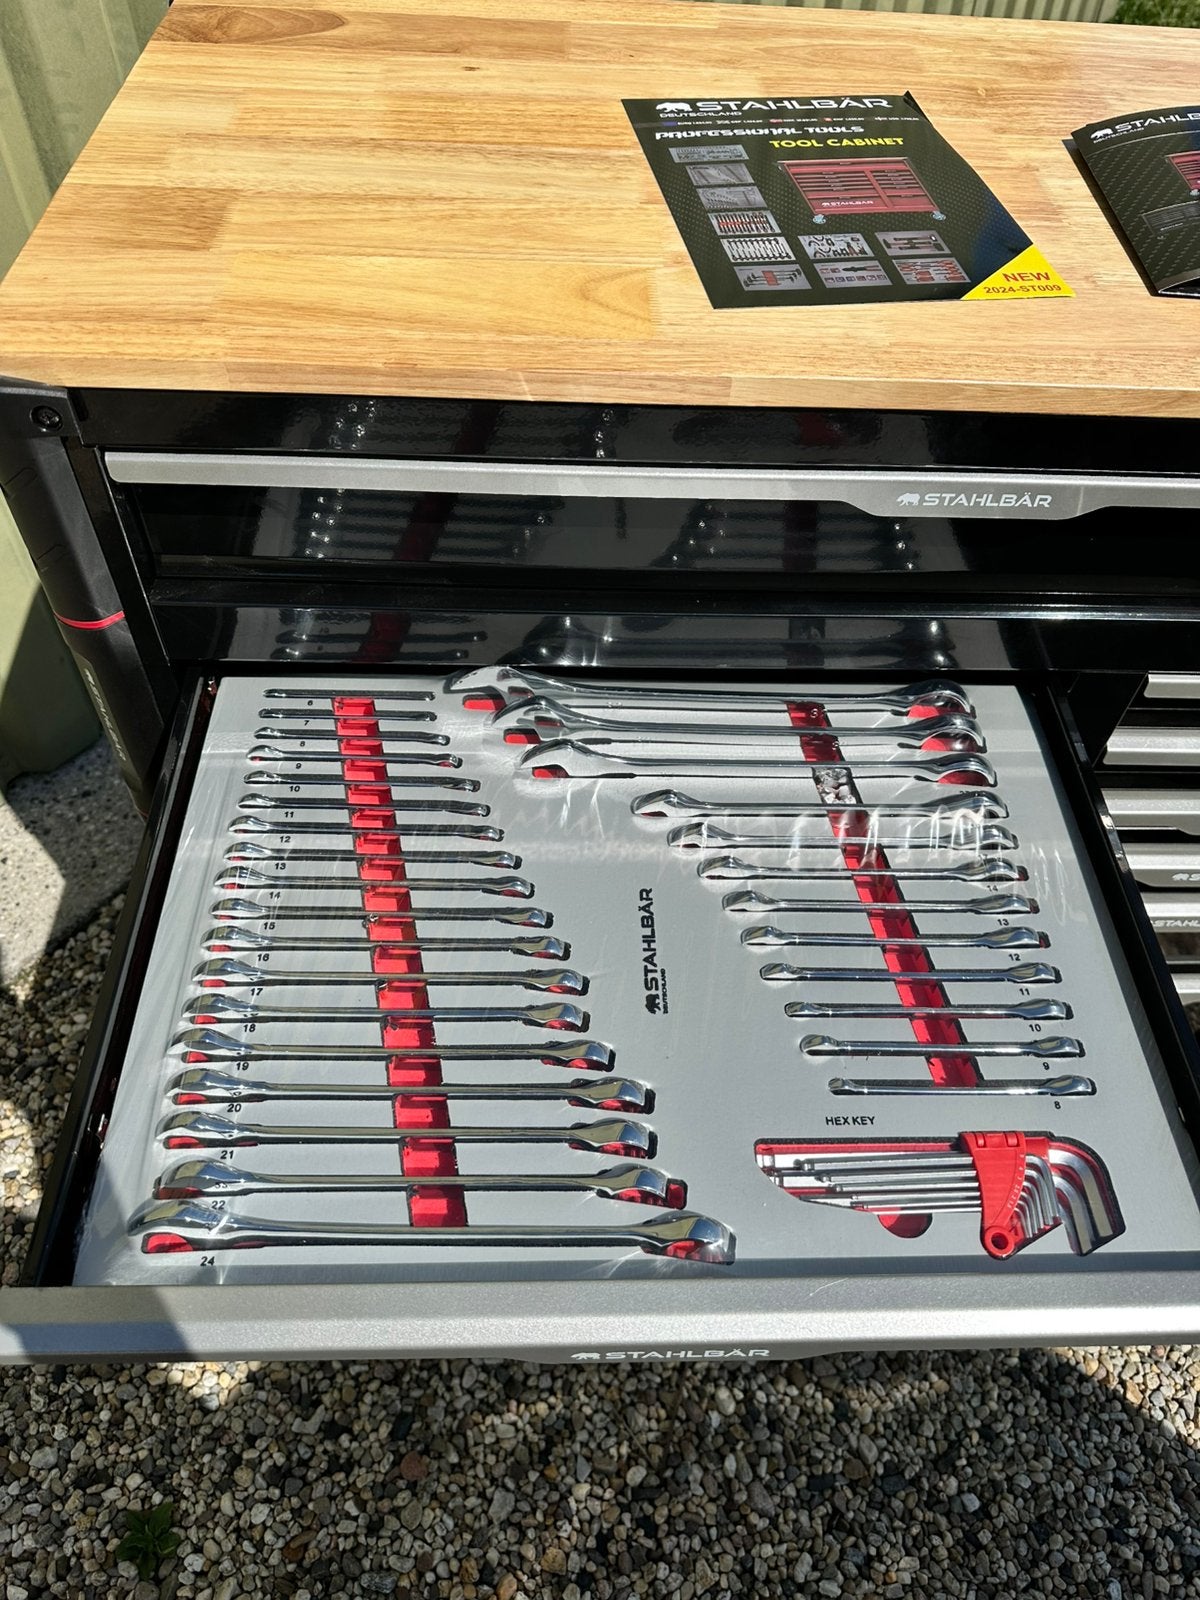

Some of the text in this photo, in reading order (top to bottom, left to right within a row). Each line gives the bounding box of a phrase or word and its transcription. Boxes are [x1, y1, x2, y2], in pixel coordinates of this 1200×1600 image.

[696, 97, 893, 112] STAHLBÄR
[655, 126, 865, 140] PROFESSIONAL TOOLS
[769, 137, 904, 148] TOOL CABINET
[1001, 272, 1050, 282] NEW
[983, 284, 1062, 293] 2024-ST009
[922, 492, 1053, 508] STAHLBÄR
[289, 785, 300, 793] 10
[274, 862, 287, 870] 13
[268, 892, 281, 900] 14
[263, 922, 276, 930] 15
[997, 918, 1010, 926] 13
[638, 887, 660, 992] STAHLBÄR
[257, 953, 270, 961] 16
[1008, 953, 1021, 961] 12
[250, 987, 263, 996] 17
[1019, 988, 1030, 996] 11
[243, 1024, 256, 1033] 18
[1029, 1023, 1042, 1032] 10
[236, 1062, 249, 1071] 19
[1043, 1062, 1050, 1070] 9
[227, 1103, 241, 1113] 20
[1054, 1101, 1061, 1109] 8
[825, 1116, 876, 1126] HEX KEY
[220, 1150, 234, 1160] 21
[211, 1200, 226, 1210] 22
[200, 1256, 215, 1267] 24
[605, 1348, 770, 1360] STAHLBÄR
